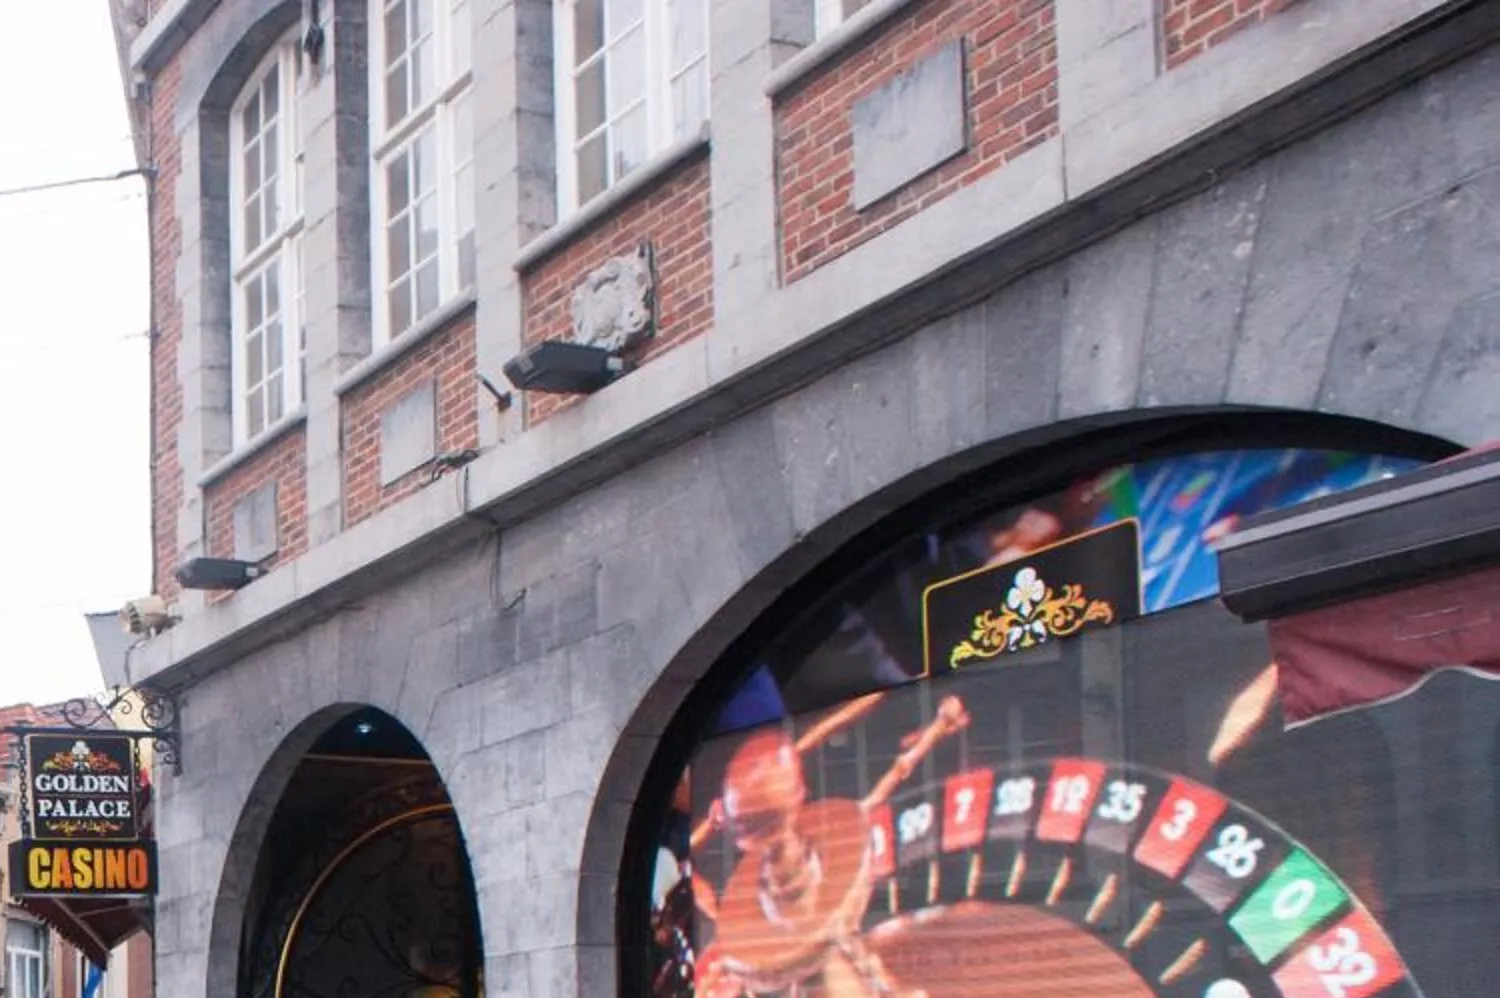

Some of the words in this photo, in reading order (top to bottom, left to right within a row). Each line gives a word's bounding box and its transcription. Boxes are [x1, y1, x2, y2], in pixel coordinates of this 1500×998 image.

[34, 774, 130, 793] GOLDEN
[1097, 779, 1148, 823] 35
[37, 799, 132, 818] PALACE
[1160, 799, 1197, 840] 3
[28, 847, 150, 889] CASINO
[1205, 823, 1266, 879] 26
[1272, 879, 1316, 921] 0
